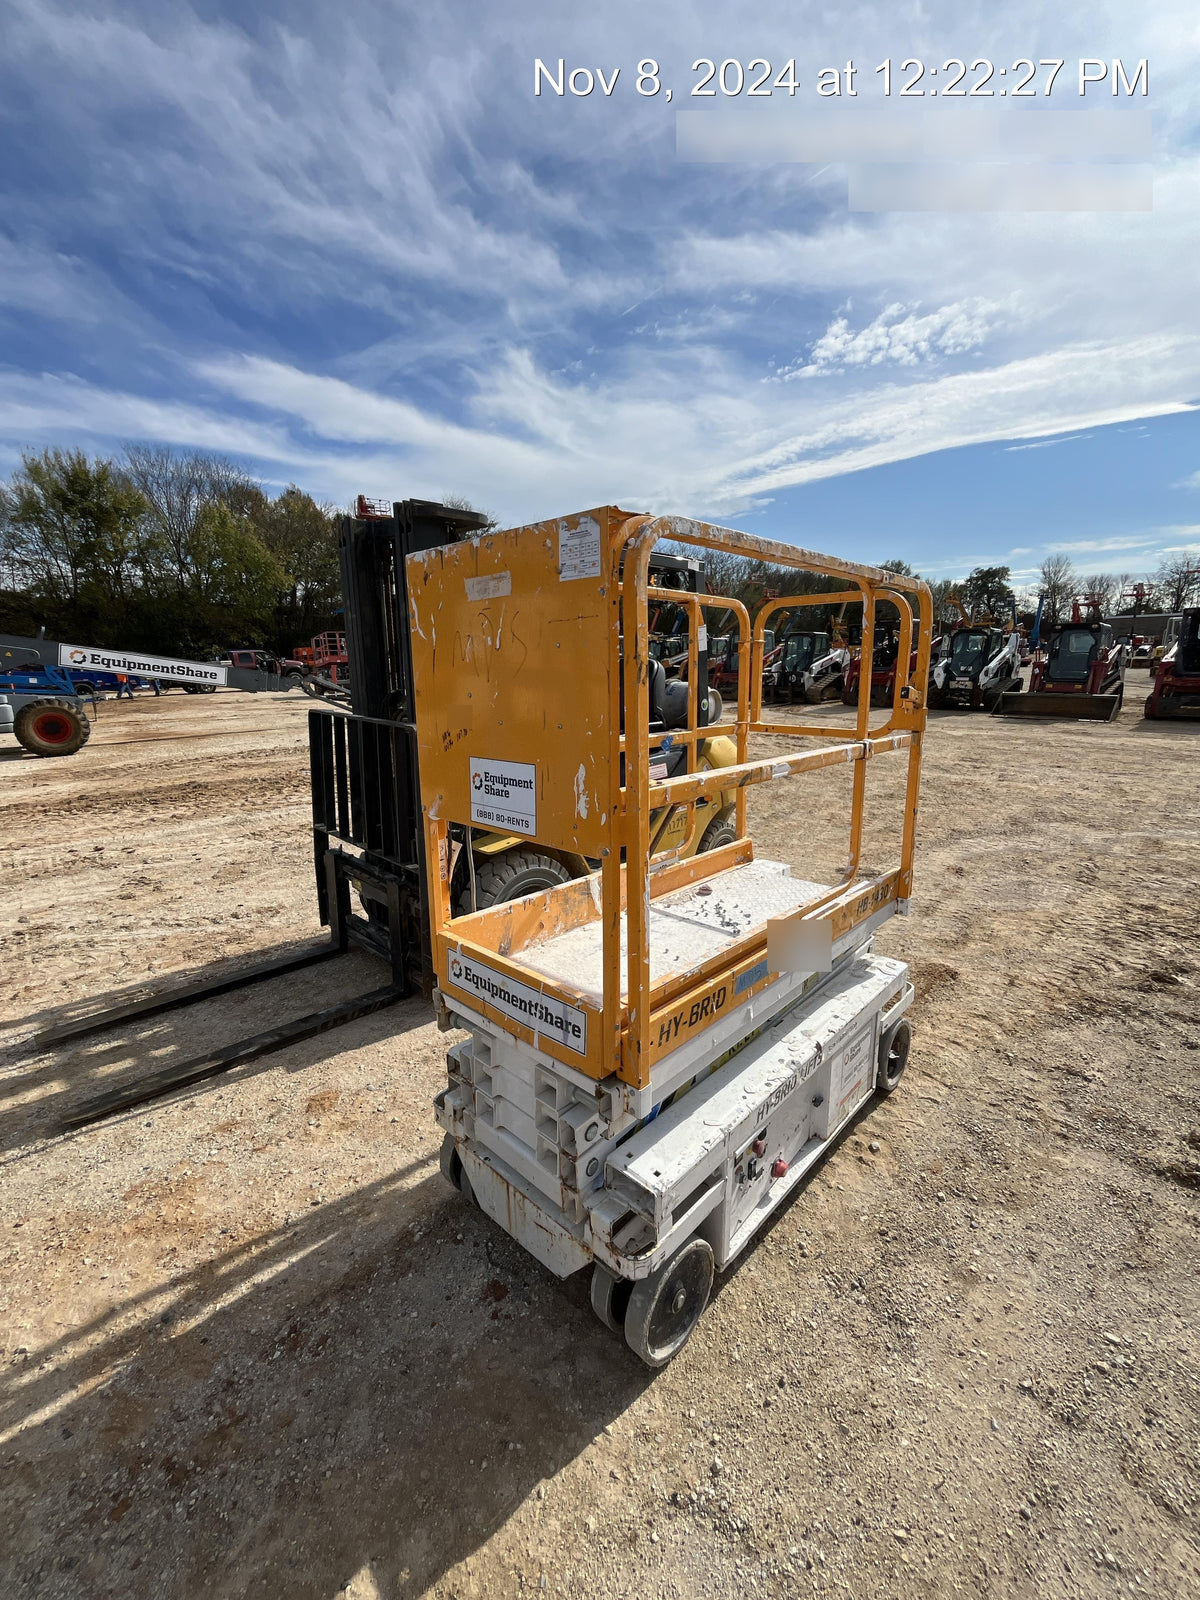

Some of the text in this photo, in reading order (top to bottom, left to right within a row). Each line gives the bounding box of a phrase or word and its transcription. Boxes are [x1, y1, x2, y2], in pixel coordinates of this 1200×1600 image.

[90, 653, 218, 680] EquipmentShare
[484, 771, 534, 790] Equipment
[484, 784, 510, 798] Share
[476, 808, 530, 829] (888) 80-RENTS
[464, 965, 582, 1040] EquipmentShare
[657, 986, 727, 1048] HY-BRID
